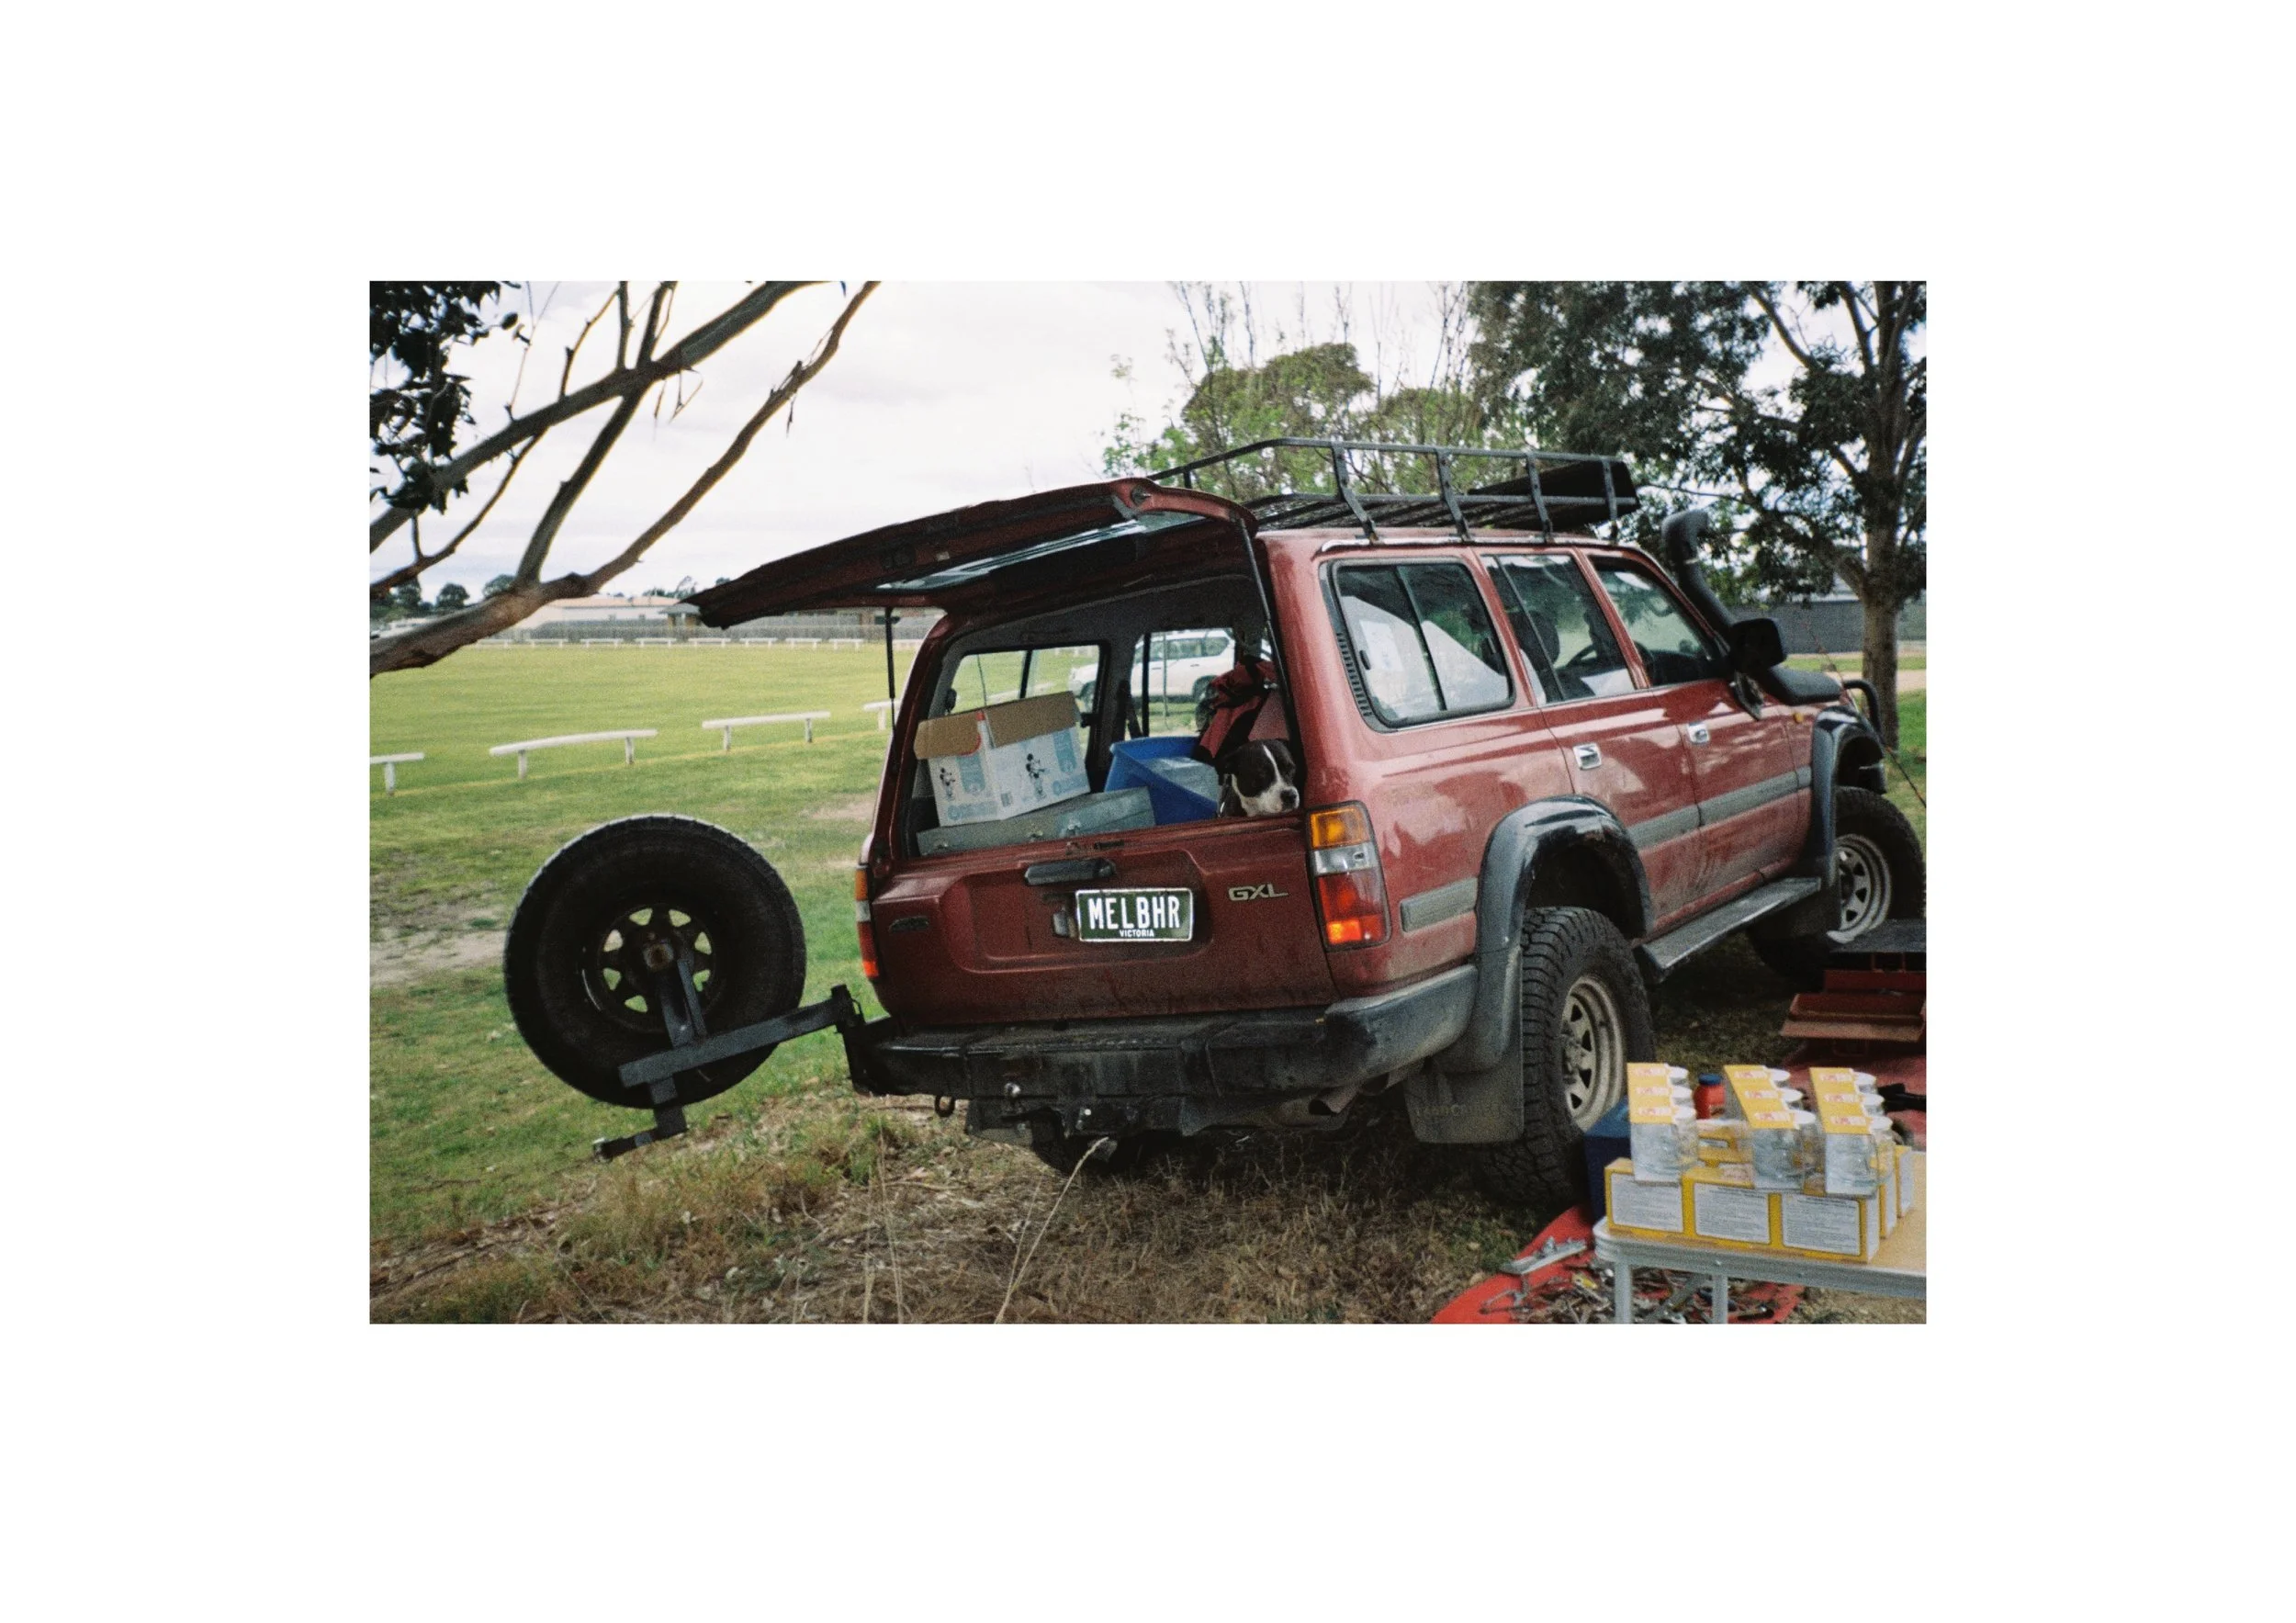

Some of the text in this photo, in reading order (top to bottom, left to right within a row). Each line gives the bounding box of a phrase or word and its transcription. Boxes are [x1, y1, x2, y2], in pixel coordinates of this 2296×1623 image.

[1228, 884, 1289, 901] GXL
[1088, 896, 1180, 930] MELBHR
[1120, 929, 1154, 938] VICTORIA
